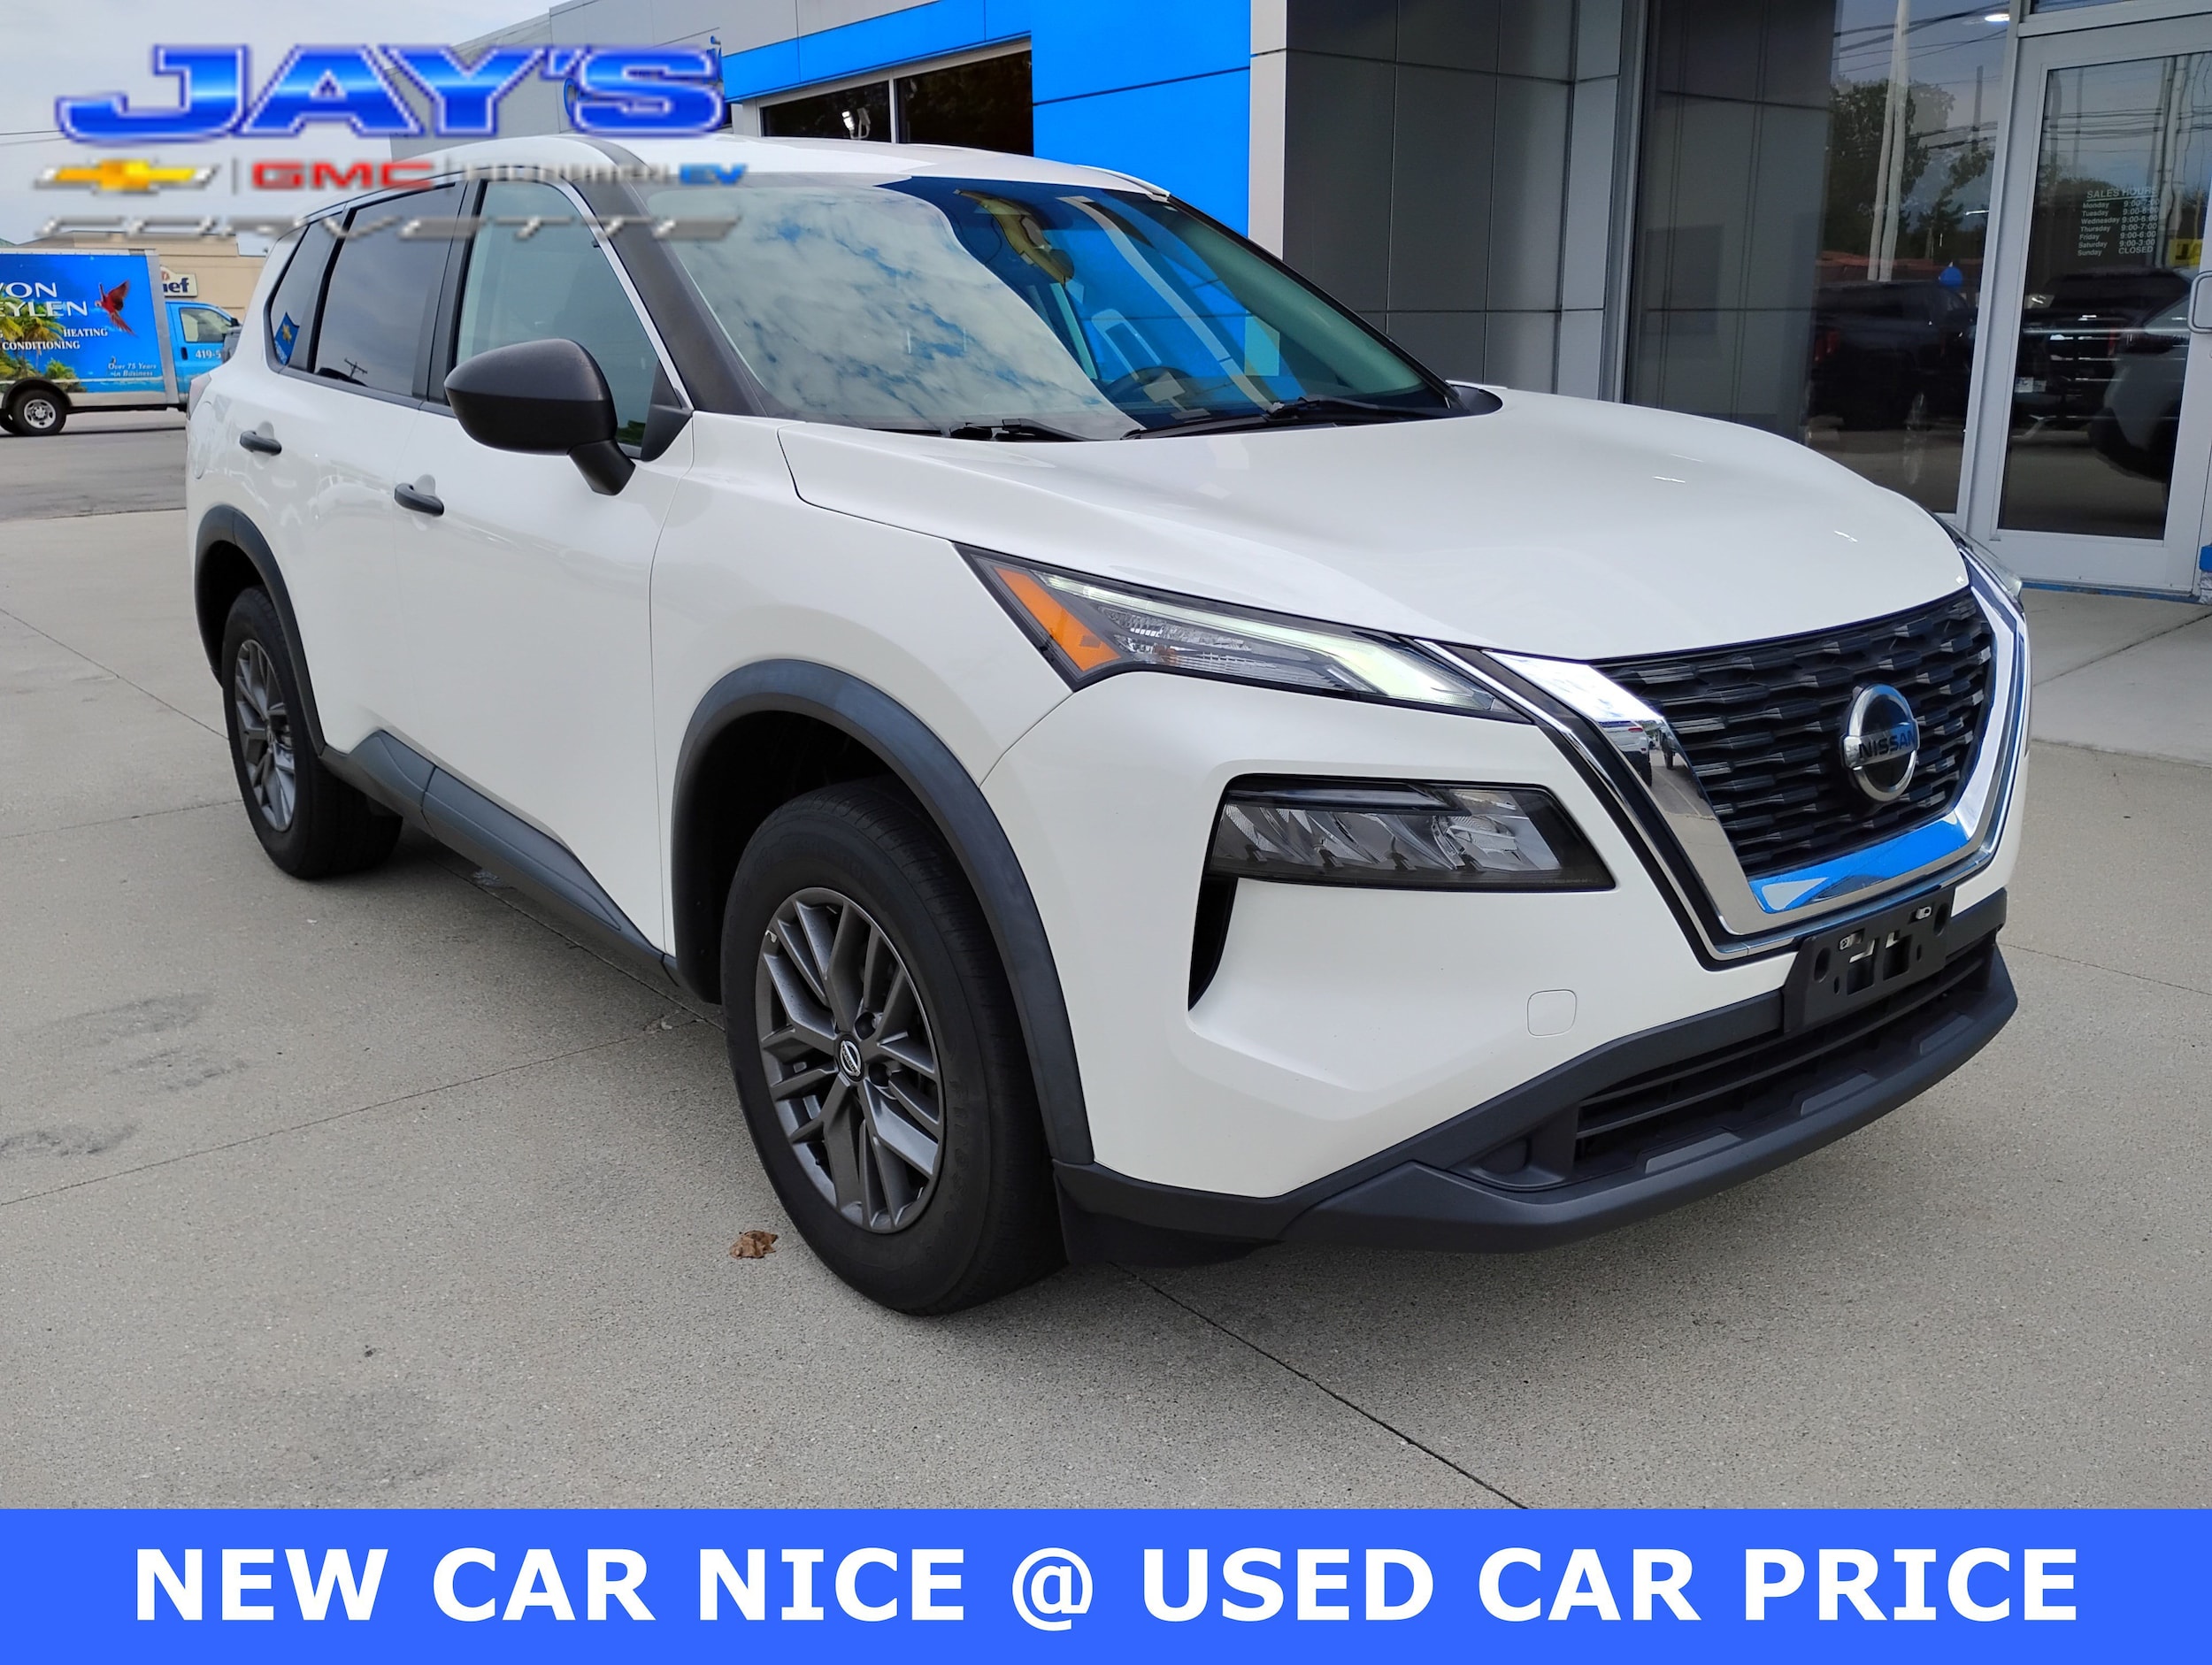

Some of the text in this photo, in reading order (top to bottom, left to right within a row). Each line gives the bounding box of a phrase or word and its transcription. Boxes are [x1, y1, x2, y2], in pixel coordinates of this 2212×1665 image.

[2087, 186, 2158, 199] SALES HOURS
[2118, 246, 2154, 255] CLOSED
[0, 281, 58, 298] ON
[162, 277, 189, 293] ief
[63, 327, 108, 338] HEATING
[2, 341, 81, 350] CONDITIONING
[196, 349, 222, 358] 419-5
[1858, 729, 1916, 758] NISSAN
